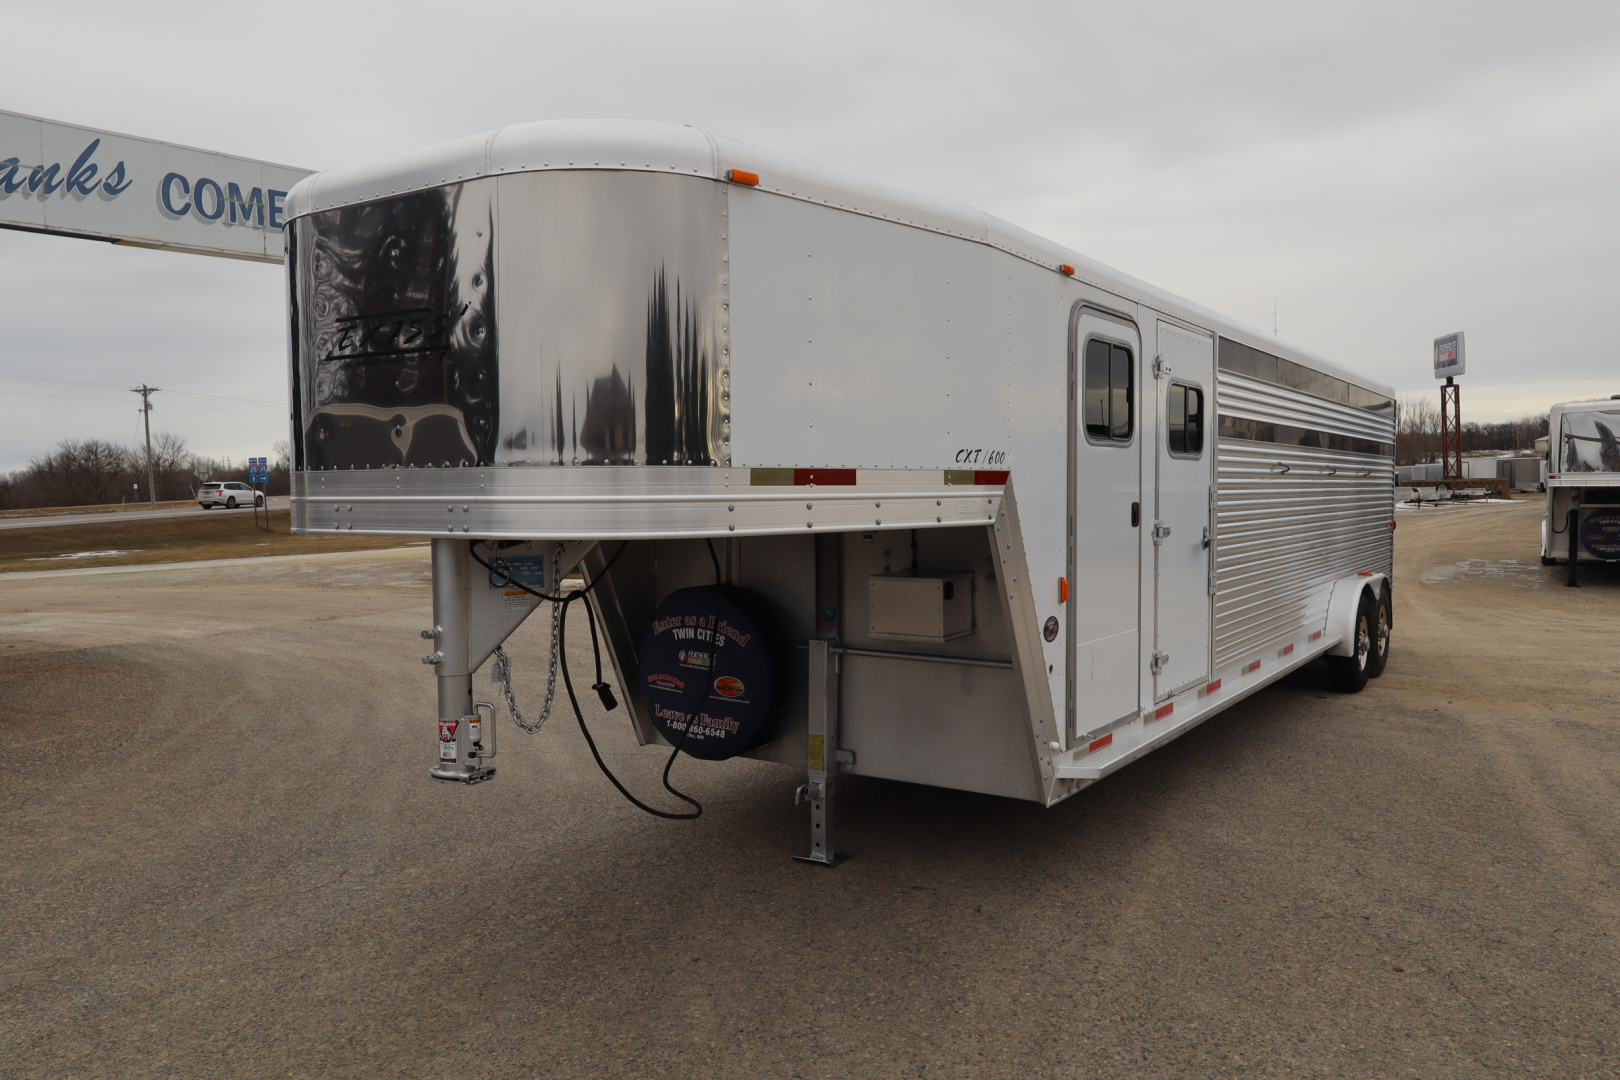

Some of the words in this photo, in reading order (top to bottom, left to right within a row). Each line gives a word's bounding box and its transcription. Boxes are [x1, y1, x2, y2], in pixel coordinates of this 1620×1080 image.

[652, 616, 683, 636] Enter
[684, 616, 697, 626] as
[698, 617, 706, 627] a
[672, 628, 695, 640] TWIN
[655, 704, 685, 722] Leave
[700, 713, 740, 735] Family
